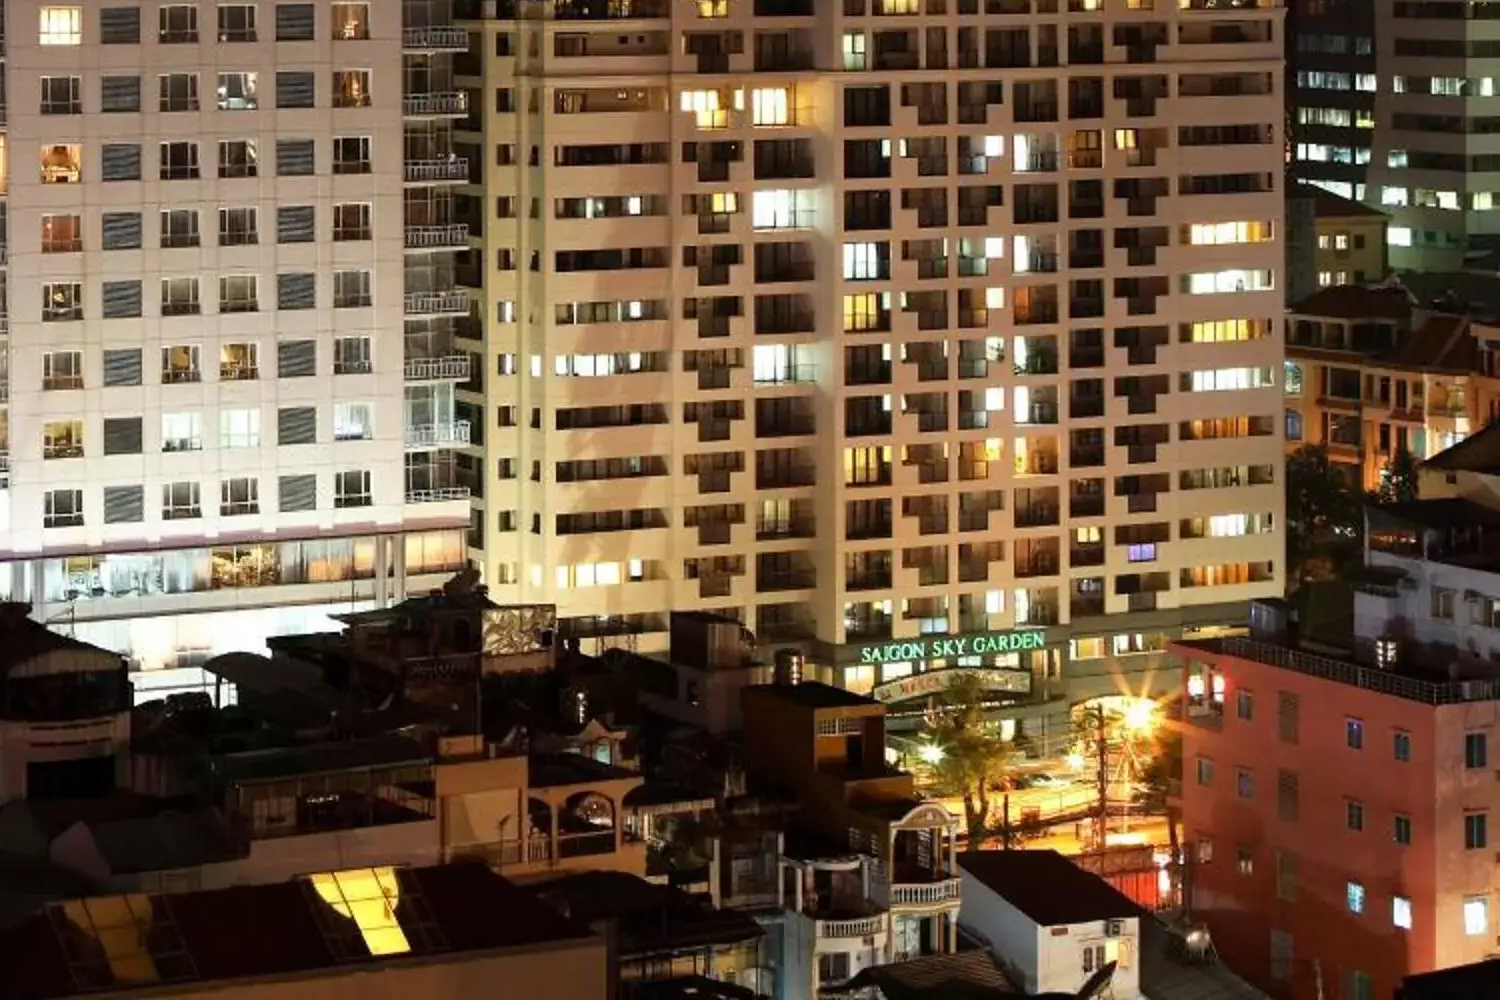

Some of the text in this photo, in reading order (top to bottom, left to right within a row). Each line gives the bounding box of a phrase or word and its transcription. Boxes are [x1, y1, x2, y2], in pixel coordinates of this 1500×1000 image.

[861, 632, 1045, 663] SAIGON SKY GARDEN
